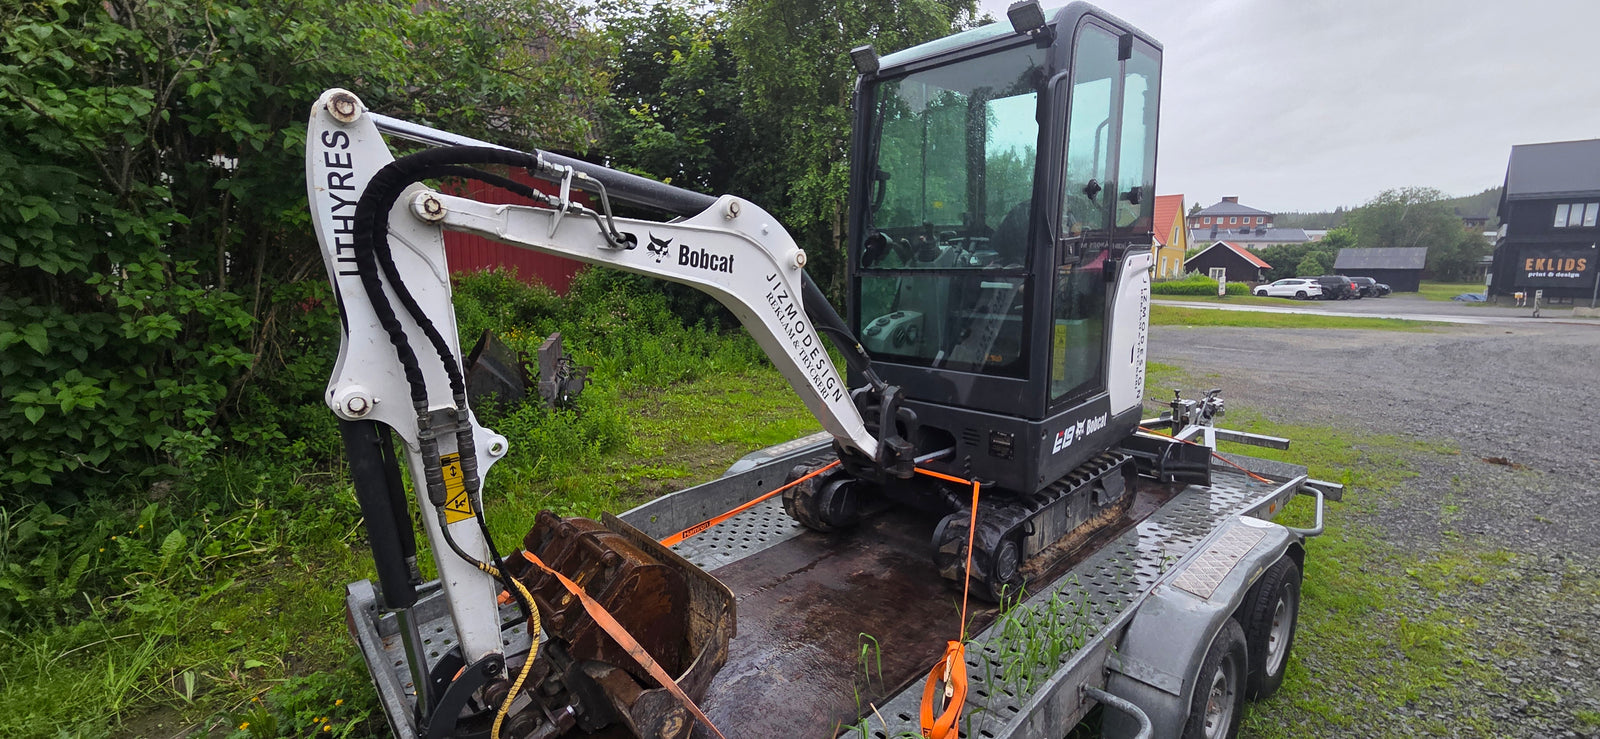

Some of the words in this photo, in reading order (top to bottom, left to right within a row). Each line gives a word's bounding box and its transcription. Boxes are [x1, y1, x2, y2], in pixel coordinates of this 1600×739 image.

[678, 244, 734, 274] Bobcat
[1525, 258, 1587, 271] EKLIDS
[765, 292, 796, 340] REKLAM
[792, 339, 801, 348] &
[799, 347, 830, 400] TRYCKERI
[766, 273, 843, 403] JIZMODESIGN
[1052, 425, 1076, 455] E19
[1086, 412, 1108, 436] Bobcat
